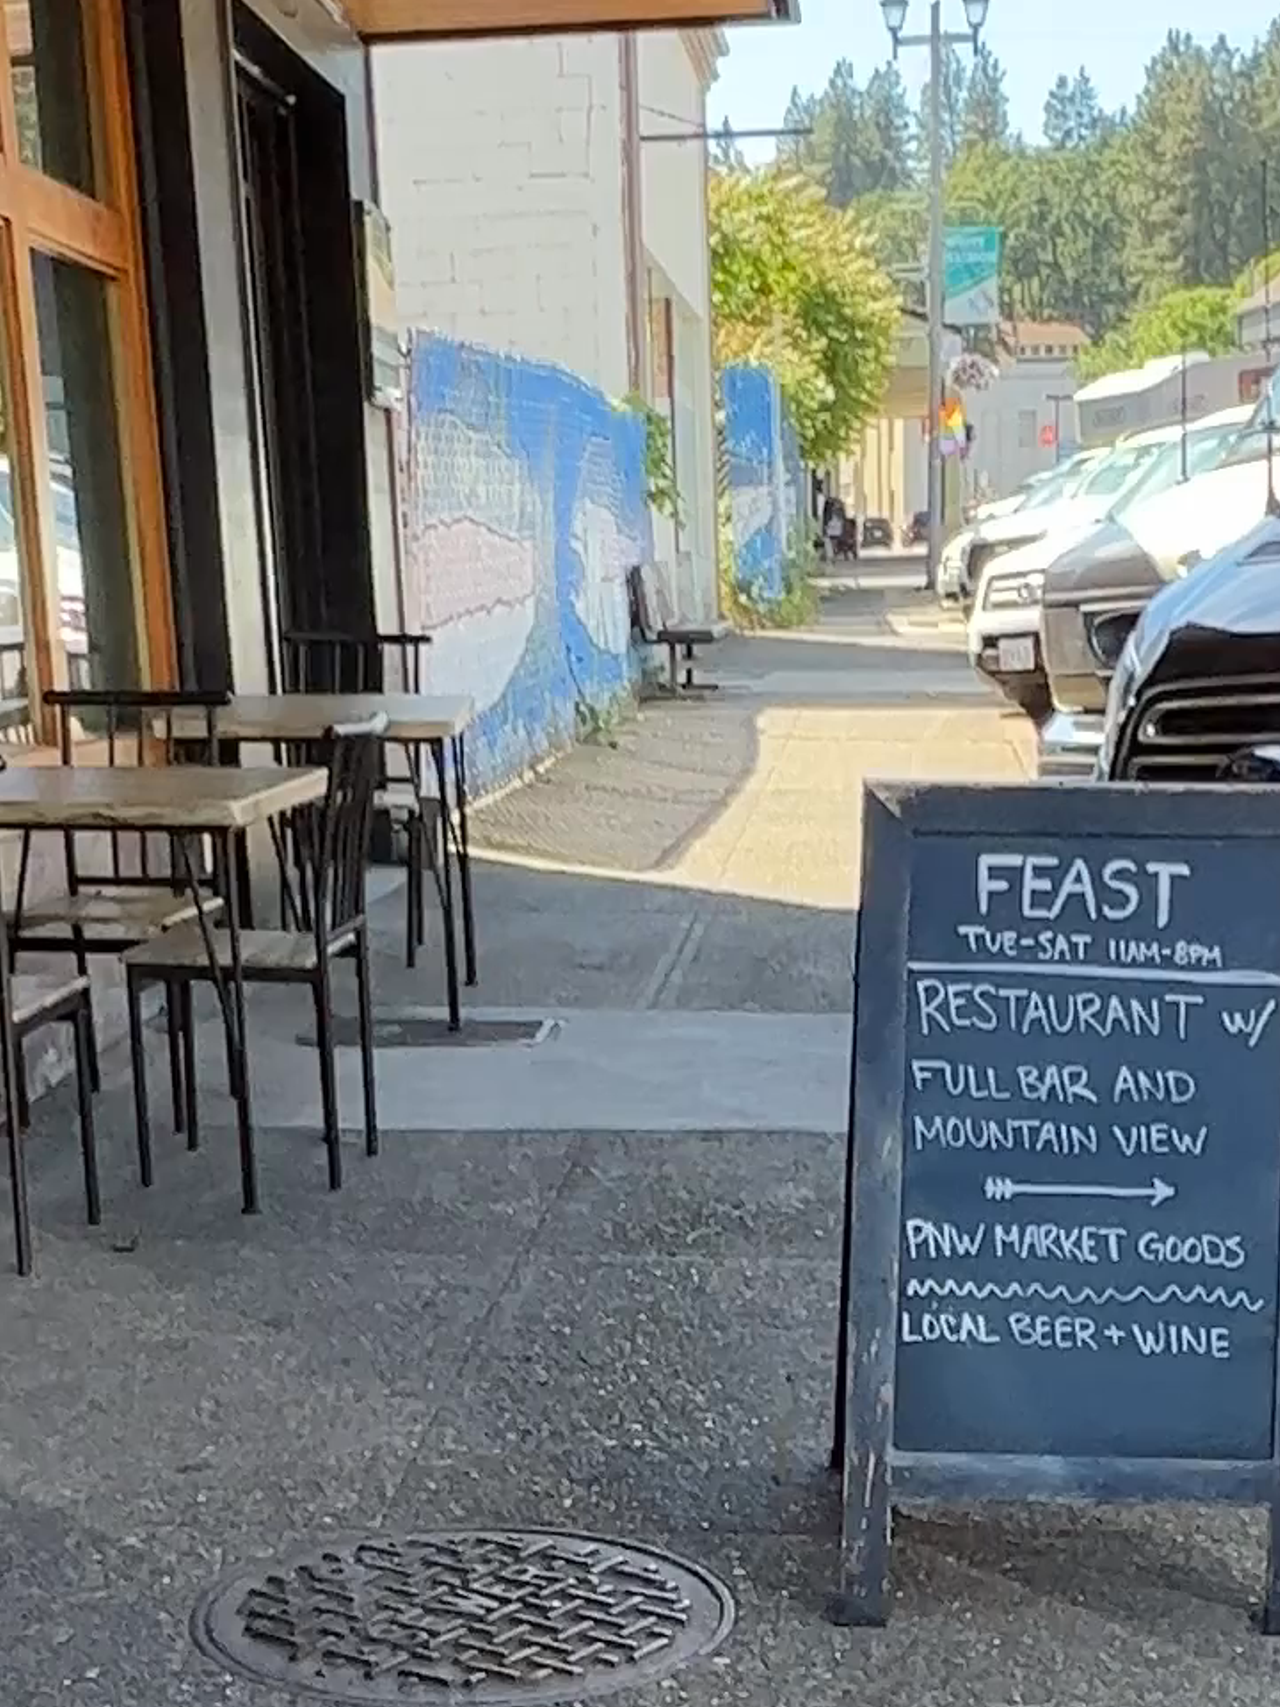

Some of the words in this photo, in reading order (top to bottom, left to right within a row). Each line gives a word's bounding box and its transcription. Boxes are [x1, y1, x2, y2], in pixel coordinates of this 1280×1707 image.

[976, 853, 1190, 929] FEAST
[957, 925, 1092, 961] TUE-SAT
[1109, 940, 1223, 968] 11AM-8PM
[916, 978, 1205, 1041] RESTAURANT
[911, 1058, 1011, 1099] FULL
[1016, 1064, 1098, 1104] BAR
[1113, 1065, 1197, 1104] AND
[913, 1115, 1098, 1155] MOUNTAIN
[1112, 1123, 1208, 1156] VIEW
[905, 1218, 986, 1260] PNW
[993, 1223, 1127, 1263] MARKET
[1137, 1231, 1246, 1270] GOODS
[901, 1310, 1000, 1344] LOCAL
[1008, 1311, 1099, 1351] BEER
[1103, 1324, 1126, 1347] +
[1132, 1323, 1231, 1359] WINE
